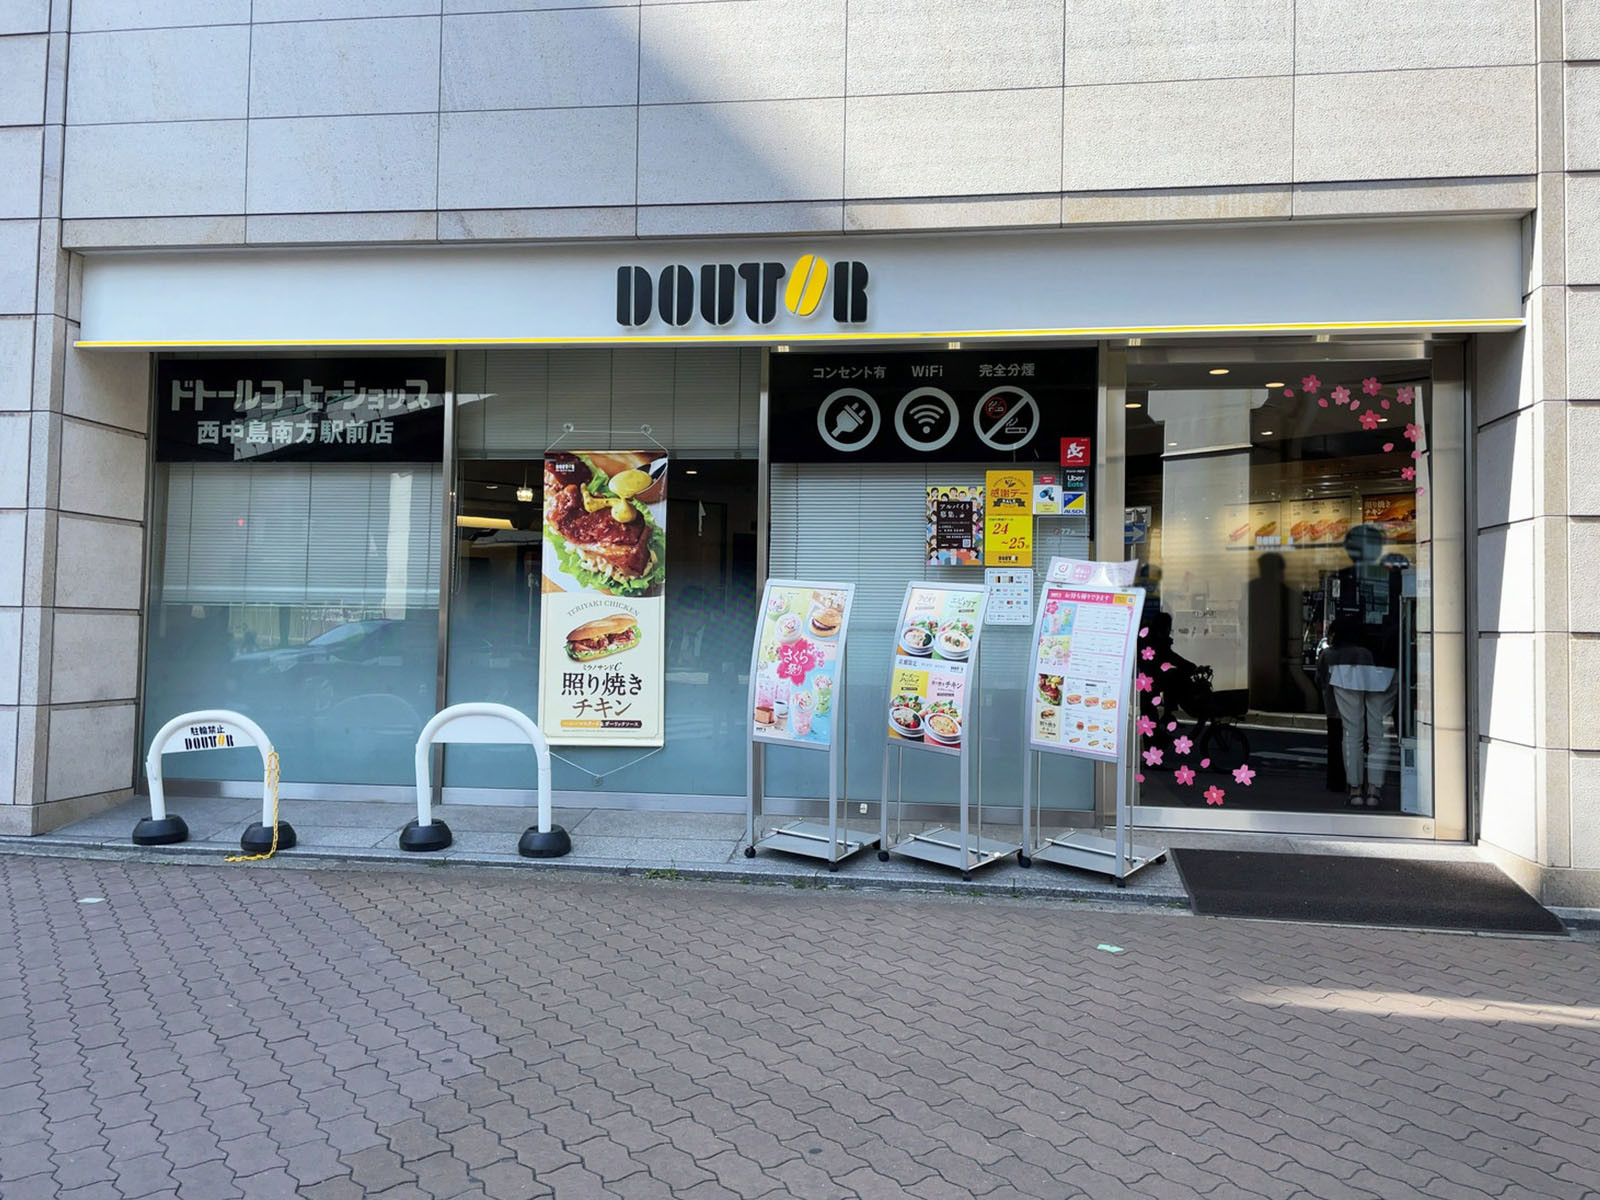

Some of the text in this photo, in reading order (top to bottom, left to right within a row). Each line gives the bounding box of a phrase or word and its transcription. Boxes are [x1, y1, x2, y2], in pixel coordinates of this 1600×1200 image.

[616, 254, 869, 326] DOUTOR
[812, 365, 887, 379] コンセント有
[911, 364, 943, 377] WiFi
[979, 363, 1035, 377] 完全分煙
[171, 379, 432, 412] ドトールコーヒーショップ
[197, 419, 394, 445] 西中島南方駅前店
[992, 523, 1009, 535] 24
[568, 600, 640, 617] TERIYAKI CHICKEN
[783, 648, 809, 665] さくら
[561, 672, 642, 696] 照り焼き
[572, 697, 632, 718] チキン
[185, 733, 235, 750] DOUTOR
